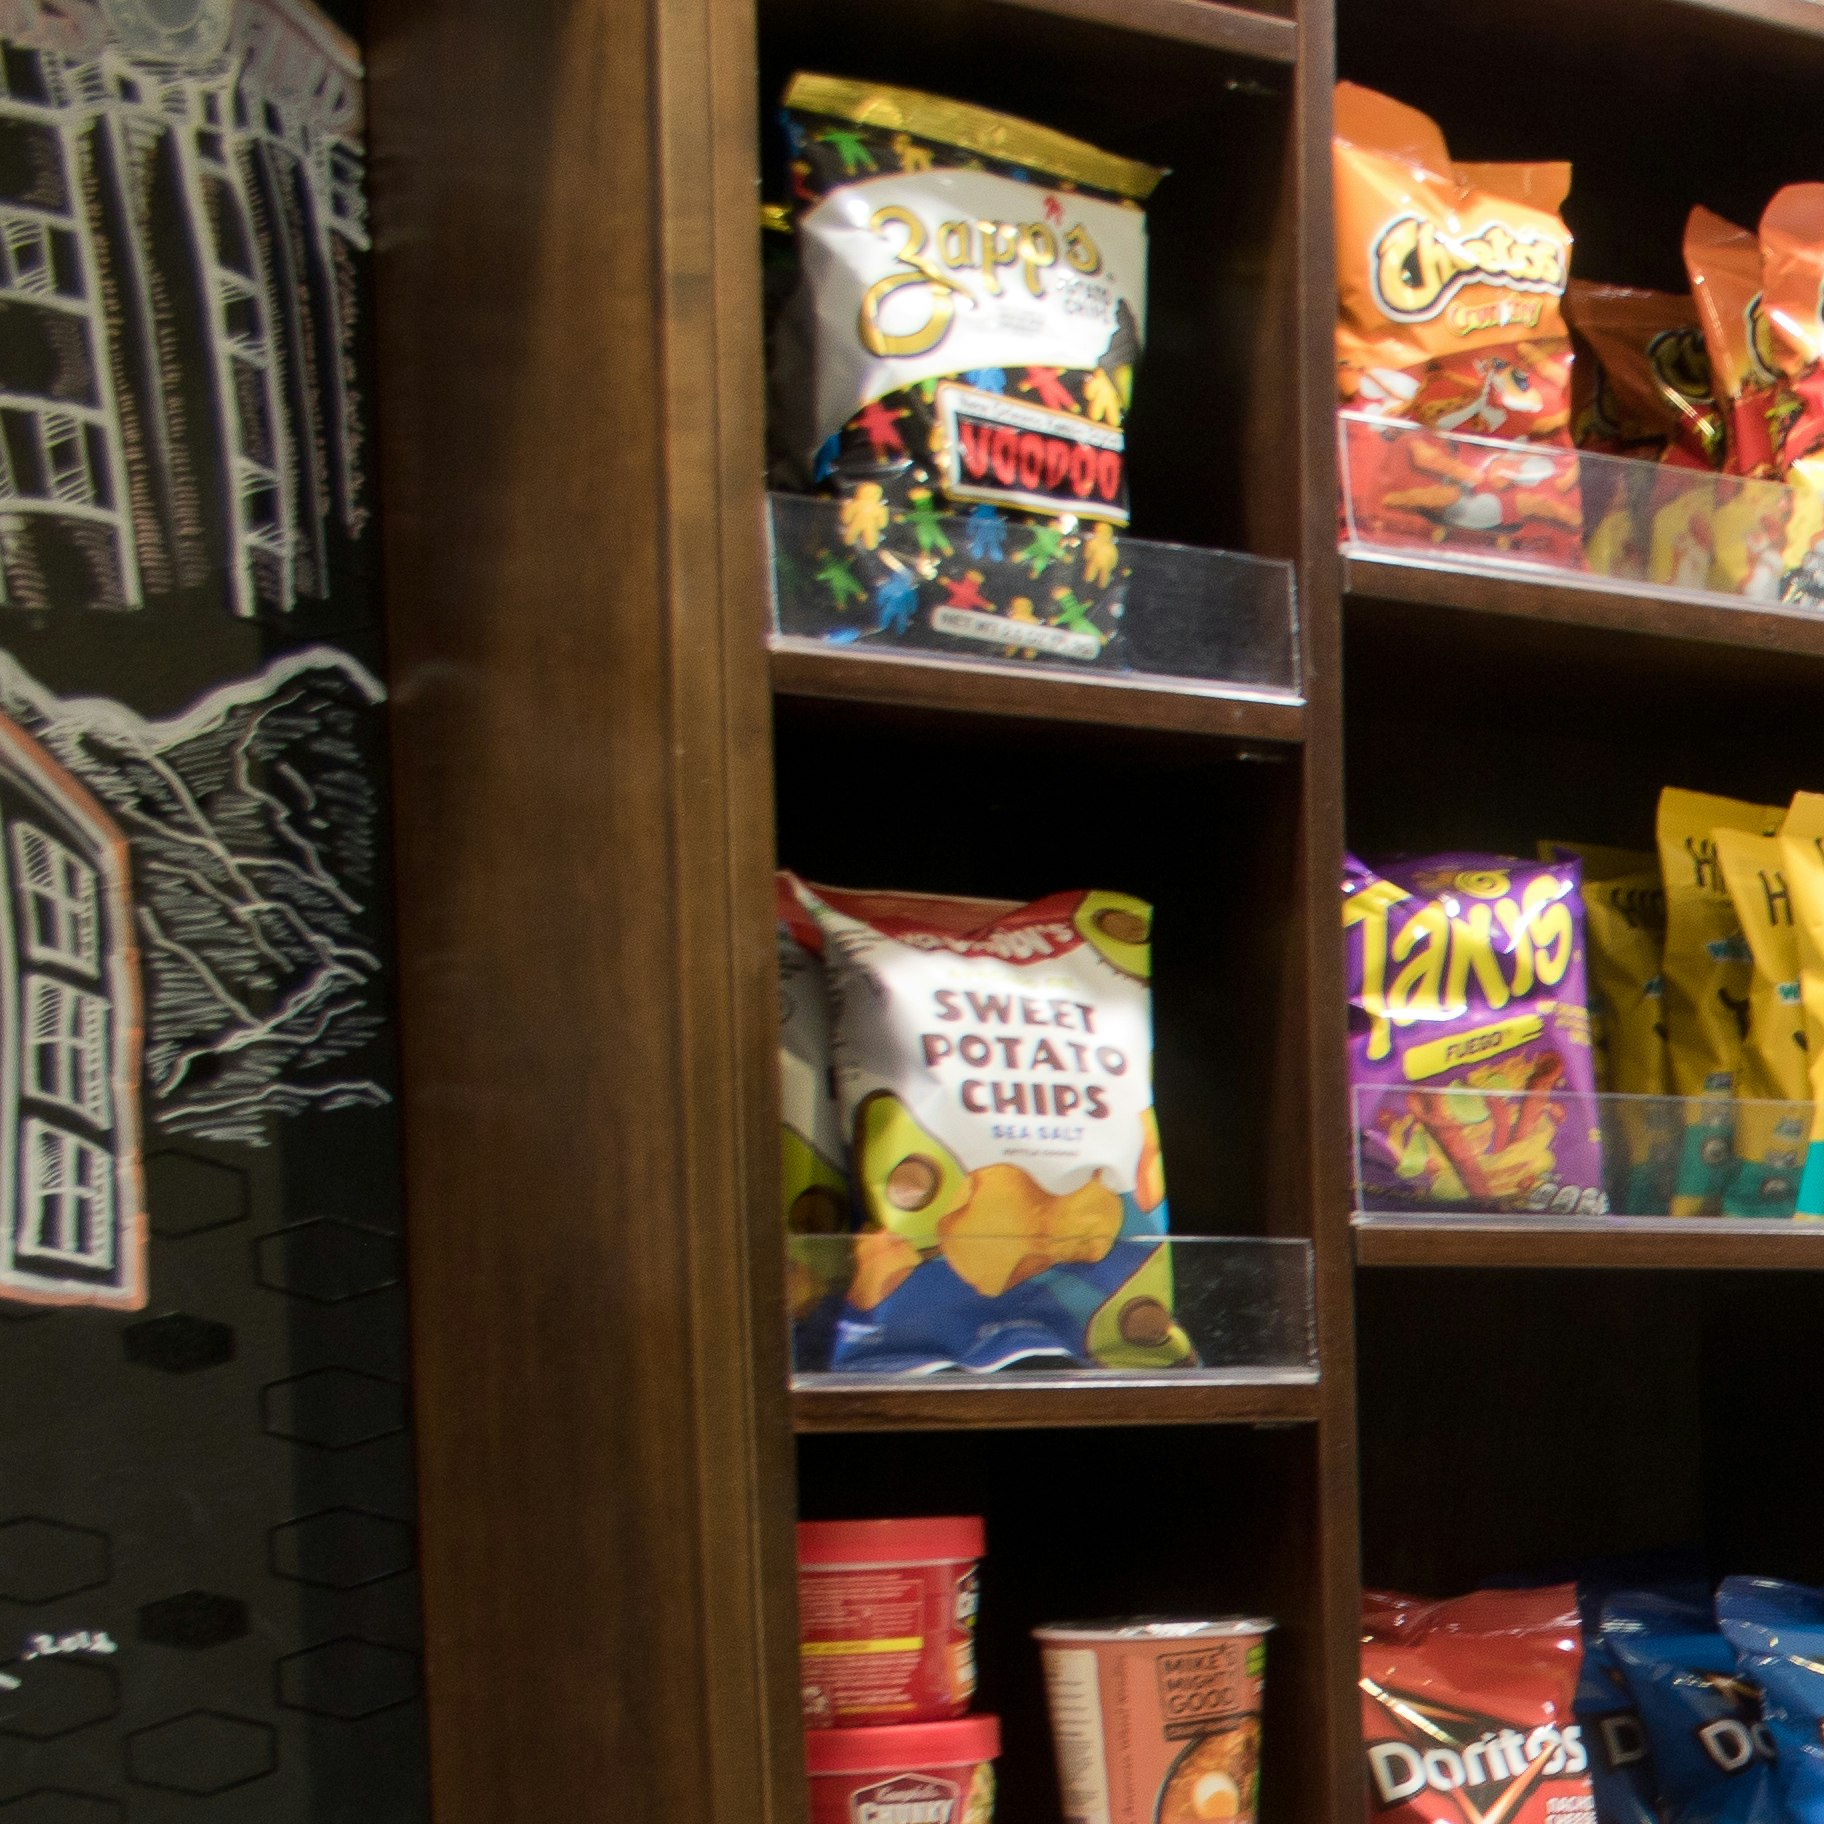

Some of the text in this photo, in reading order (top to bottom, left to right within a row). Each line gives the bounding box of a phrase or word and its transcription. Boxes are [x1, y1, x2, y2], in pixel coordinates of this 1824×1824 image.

[959, 420, 1122, 501] VOODOO
[933, 989, 1096, 1034] SWEET
[920, 1033, 1128, 1076] POTATO
[1444, 1033, 1503, 1063] FUEGO
[960, 1078, 1111, 1120] CHIPS
[1369, 1720, 1589, 1803] Doritos
